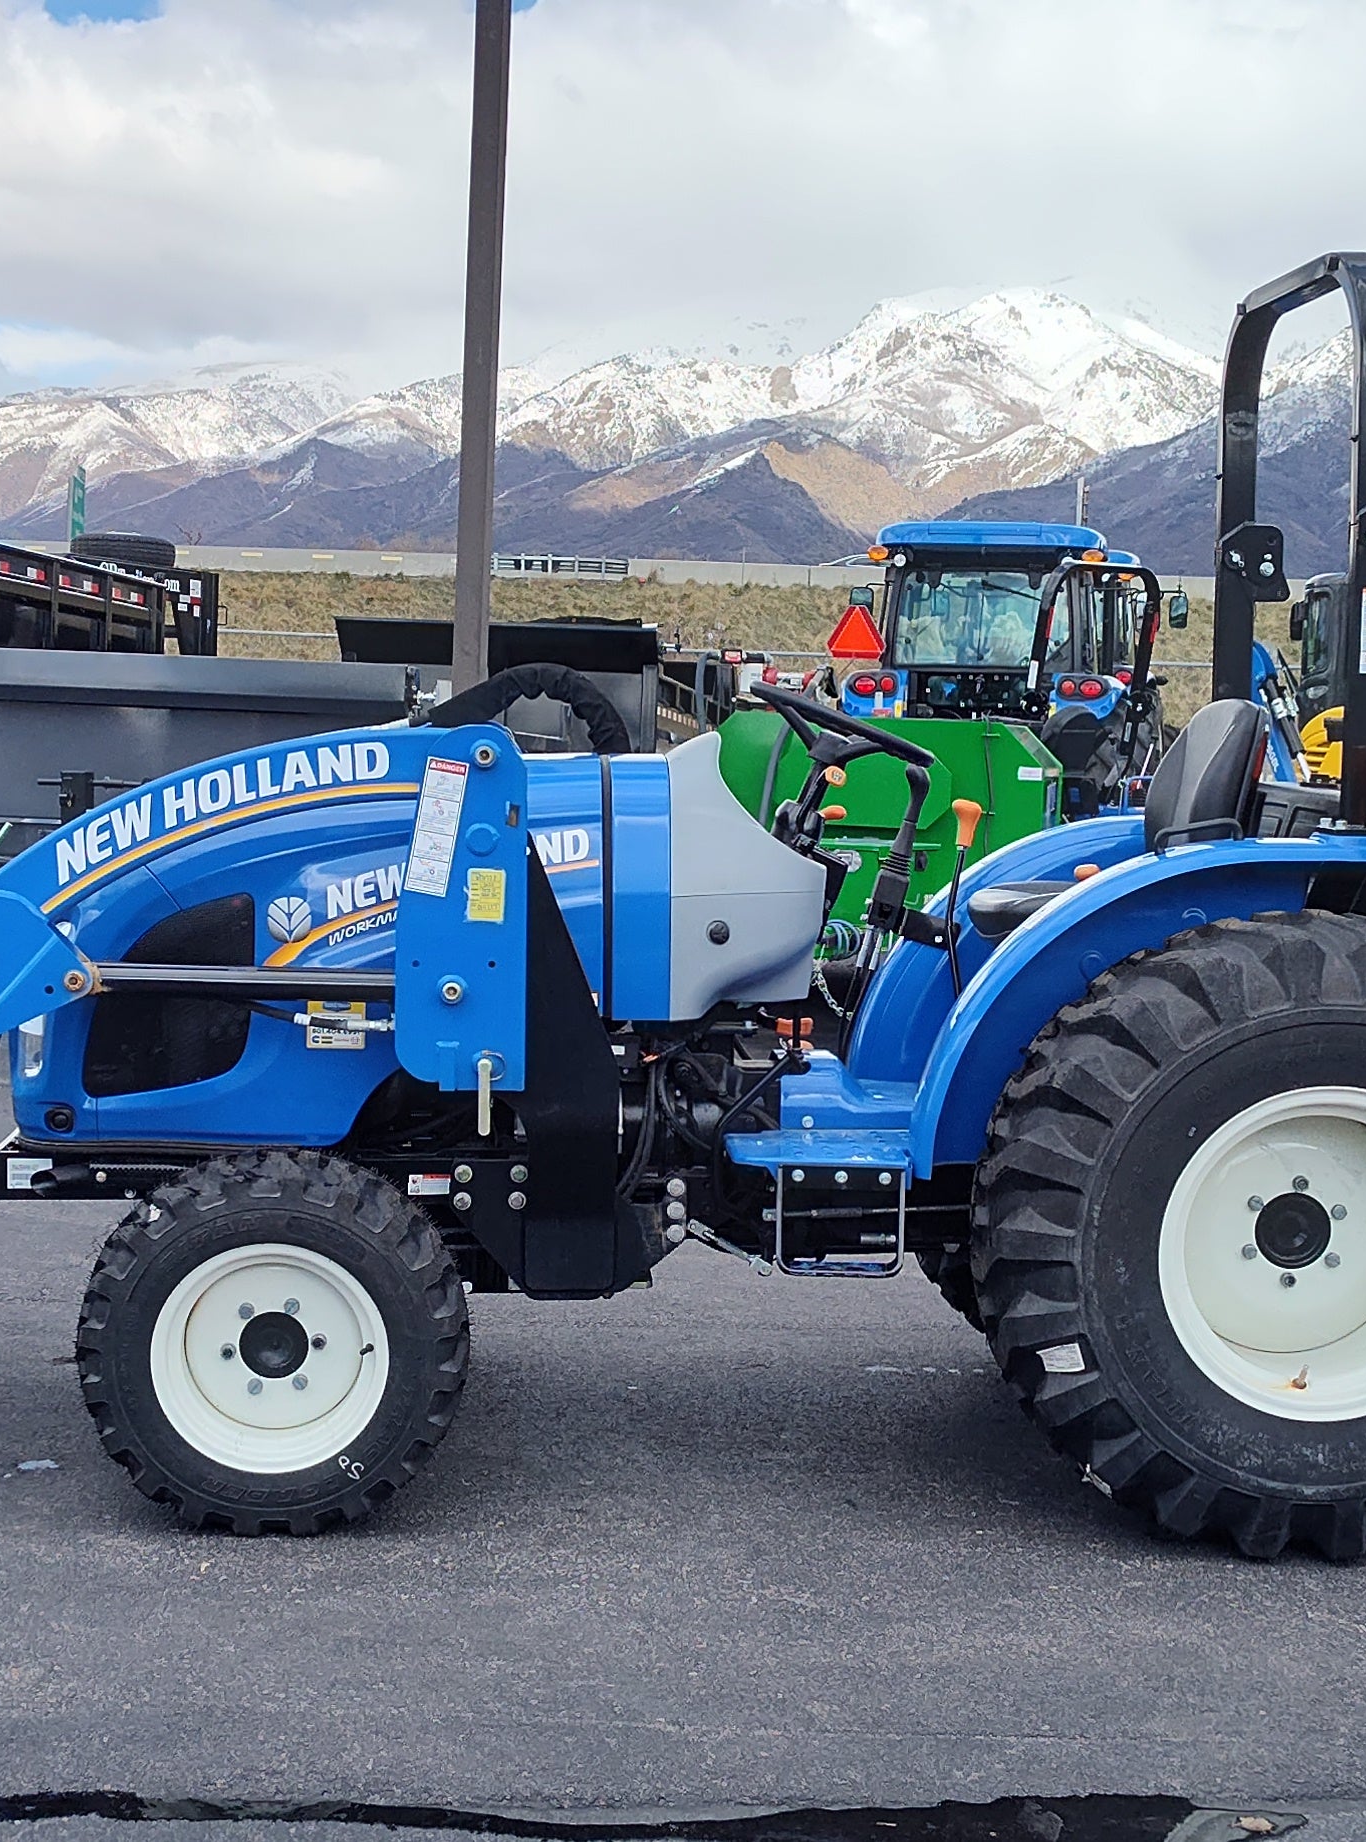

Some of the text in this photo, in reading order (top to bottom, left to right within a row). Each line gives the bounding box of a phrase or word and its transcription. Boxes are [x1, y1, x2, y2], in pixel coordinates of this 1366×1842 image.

[436, 763, 466, 774] DANGER
[55, 741, 390, 886] NEW HOLLAND
[327, 862, 407, 920] NEW
